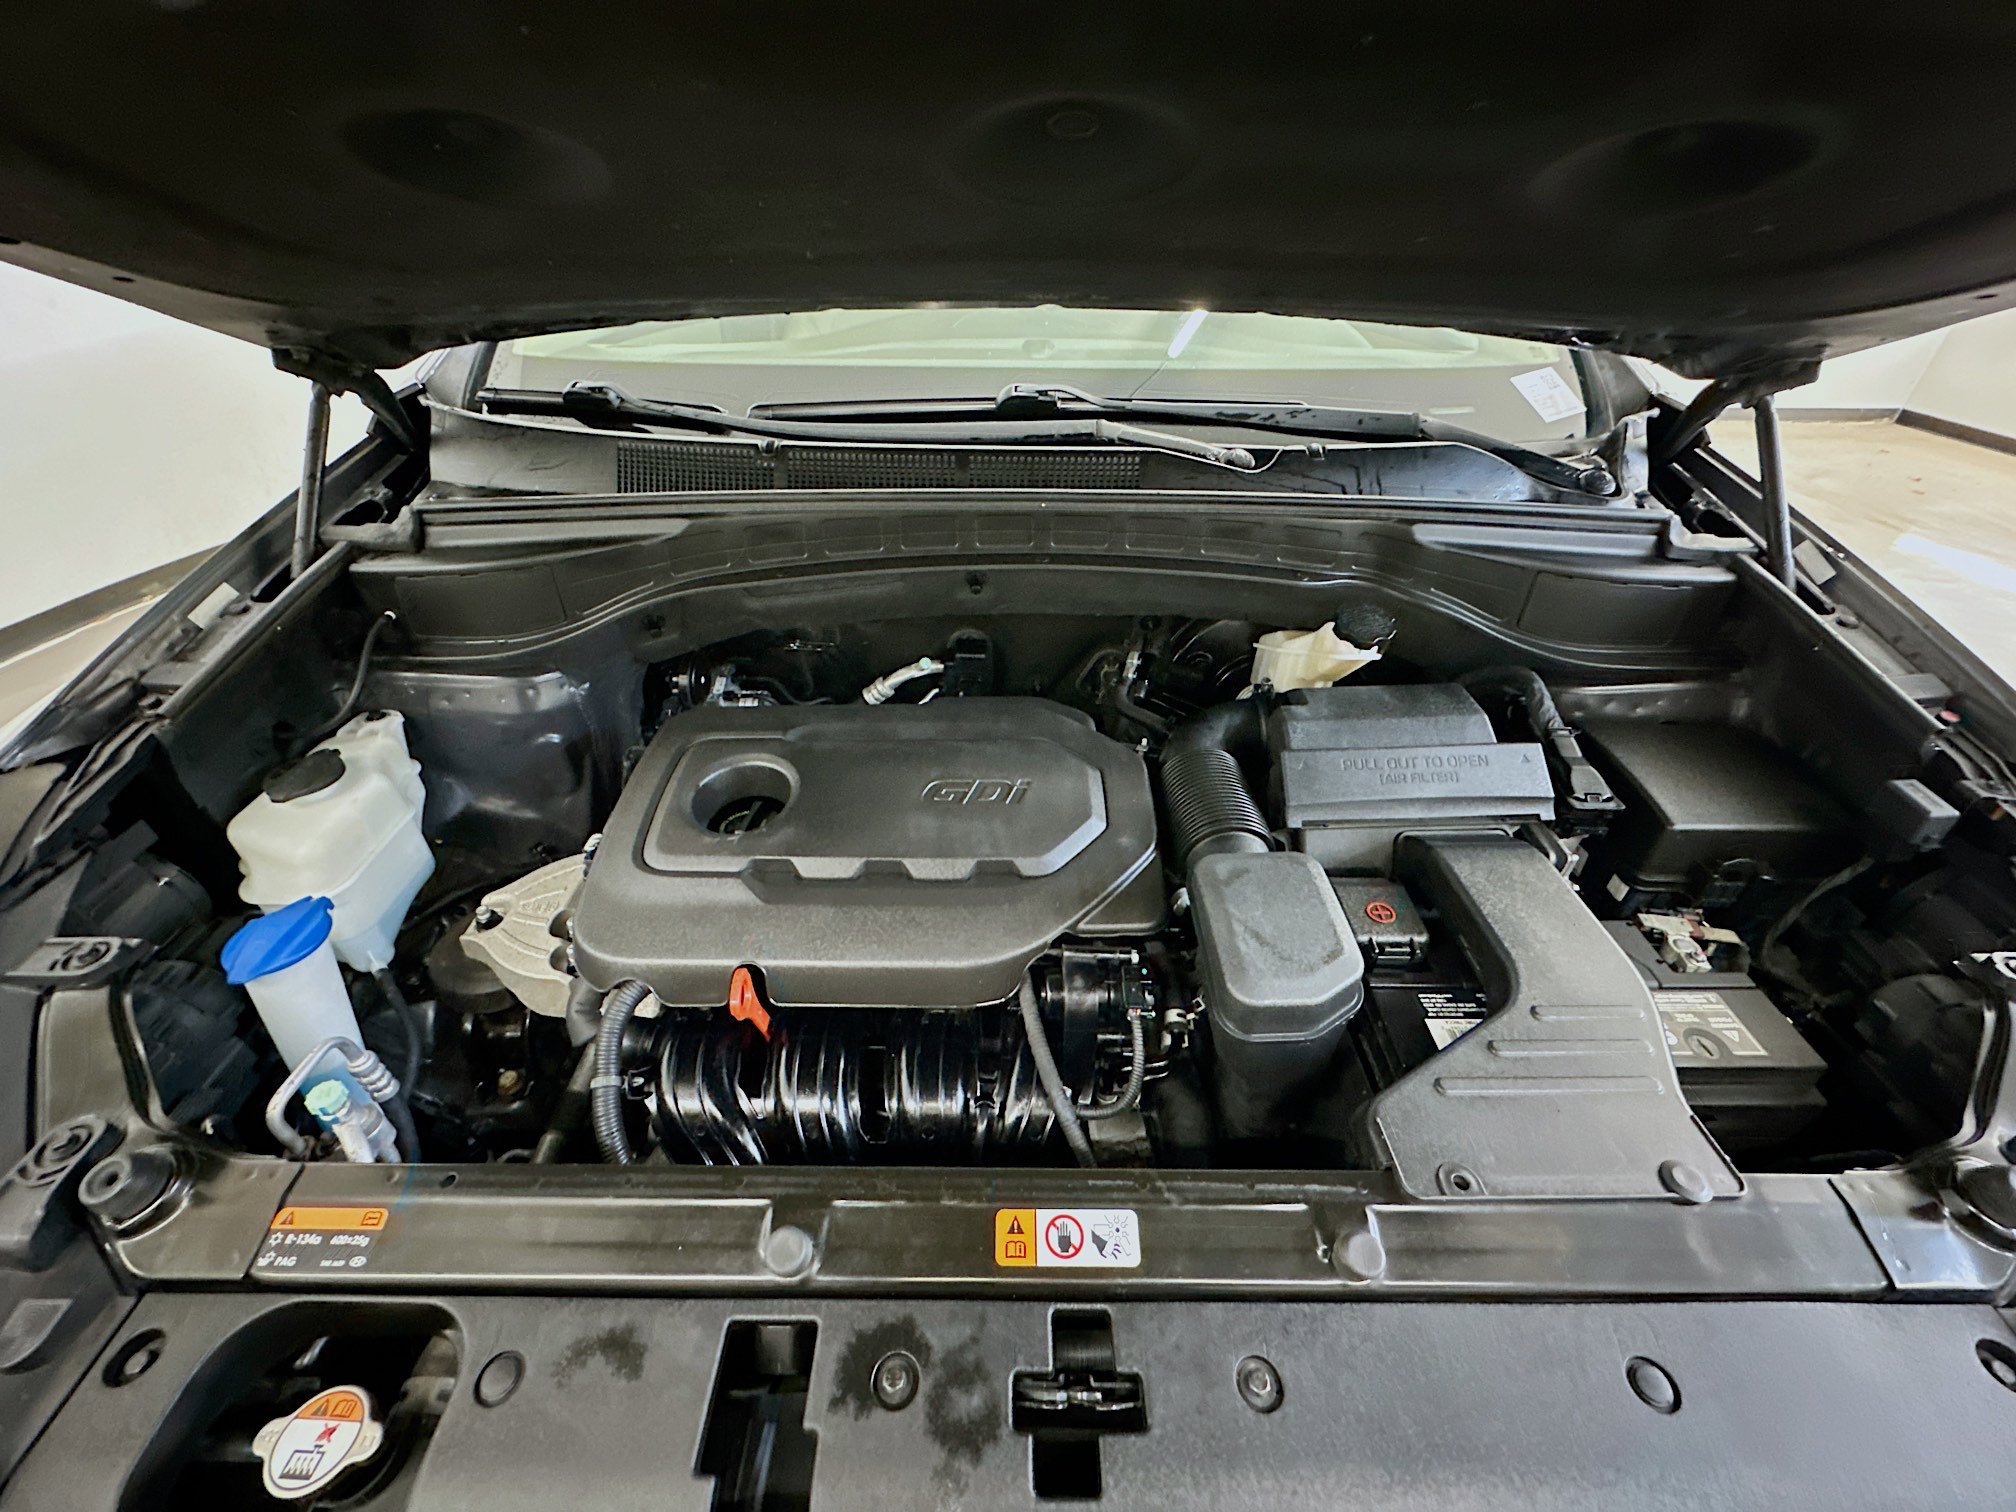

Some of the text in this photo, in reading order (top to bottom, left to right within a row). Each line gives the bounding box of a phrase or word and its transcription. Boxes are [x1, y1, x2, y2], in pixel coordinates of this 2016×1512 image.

[1341, 754, 1489, 771] PULL OUT TO OPEN
[285, 1233, 323, 1245] R-134a
[274, 1256, 297, 1267] PAG
